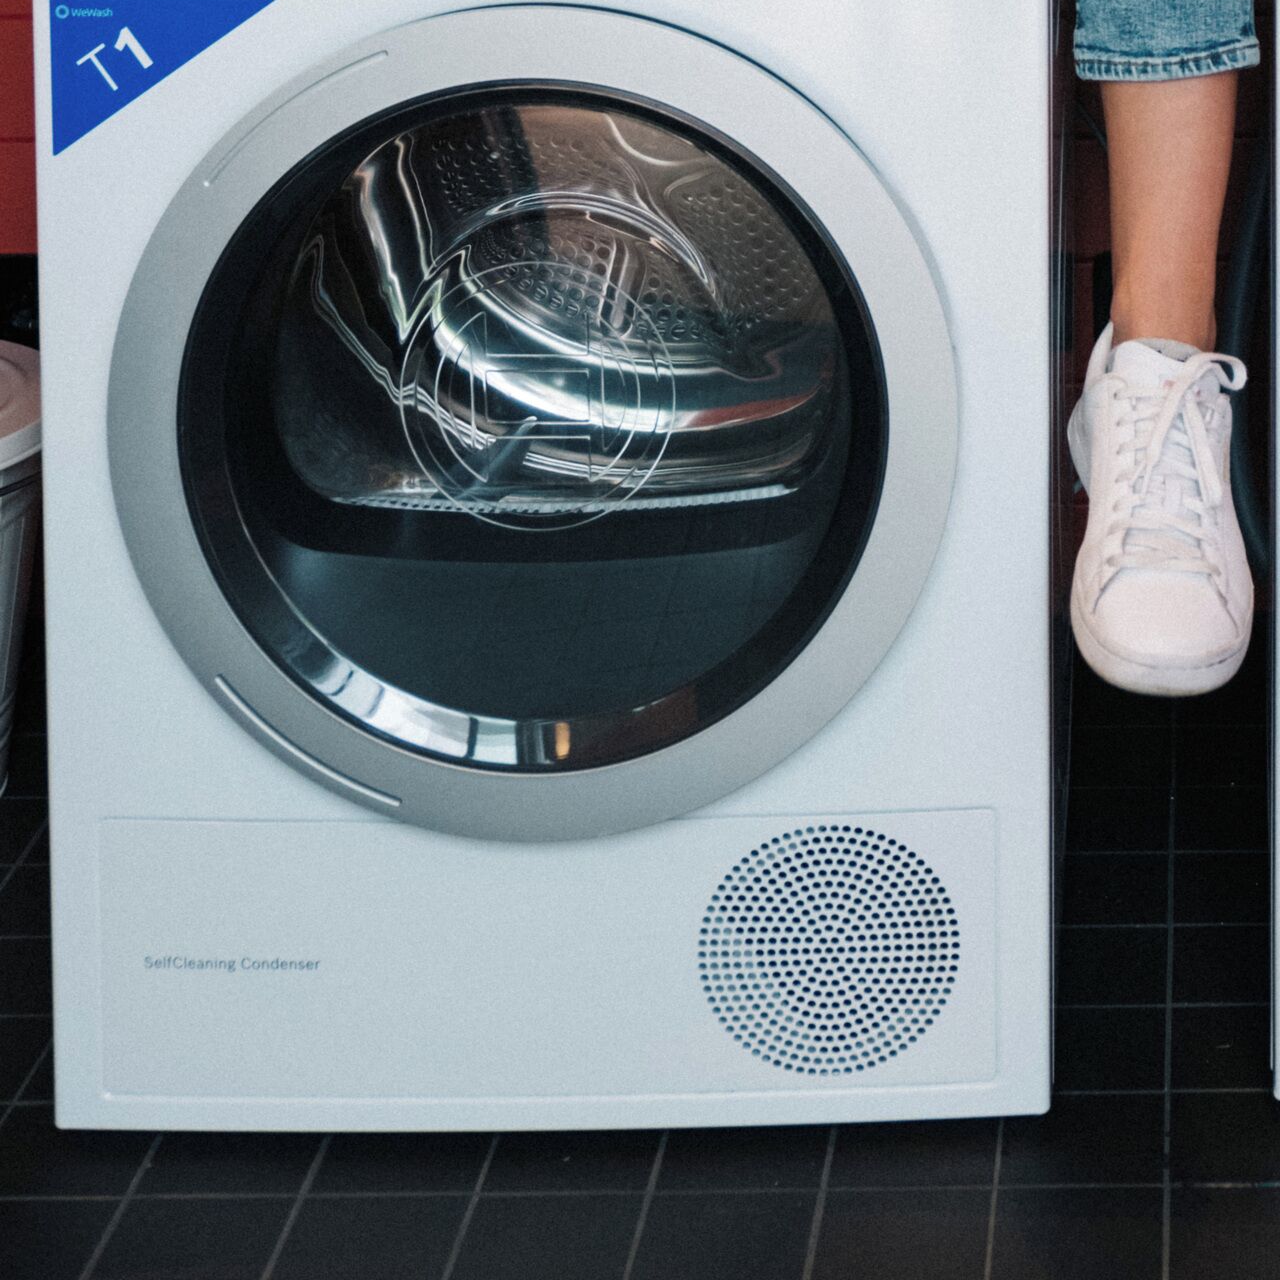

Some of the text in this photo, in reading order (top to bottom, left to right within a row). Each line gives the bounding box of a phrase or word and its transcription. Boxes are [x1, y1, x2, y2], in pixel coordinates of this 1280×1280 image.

[70, 6, 113, 18] WeWash
[76, 26, 155, 92] T1
[144, 955, 321, 972] SelfCleaning Condenser
